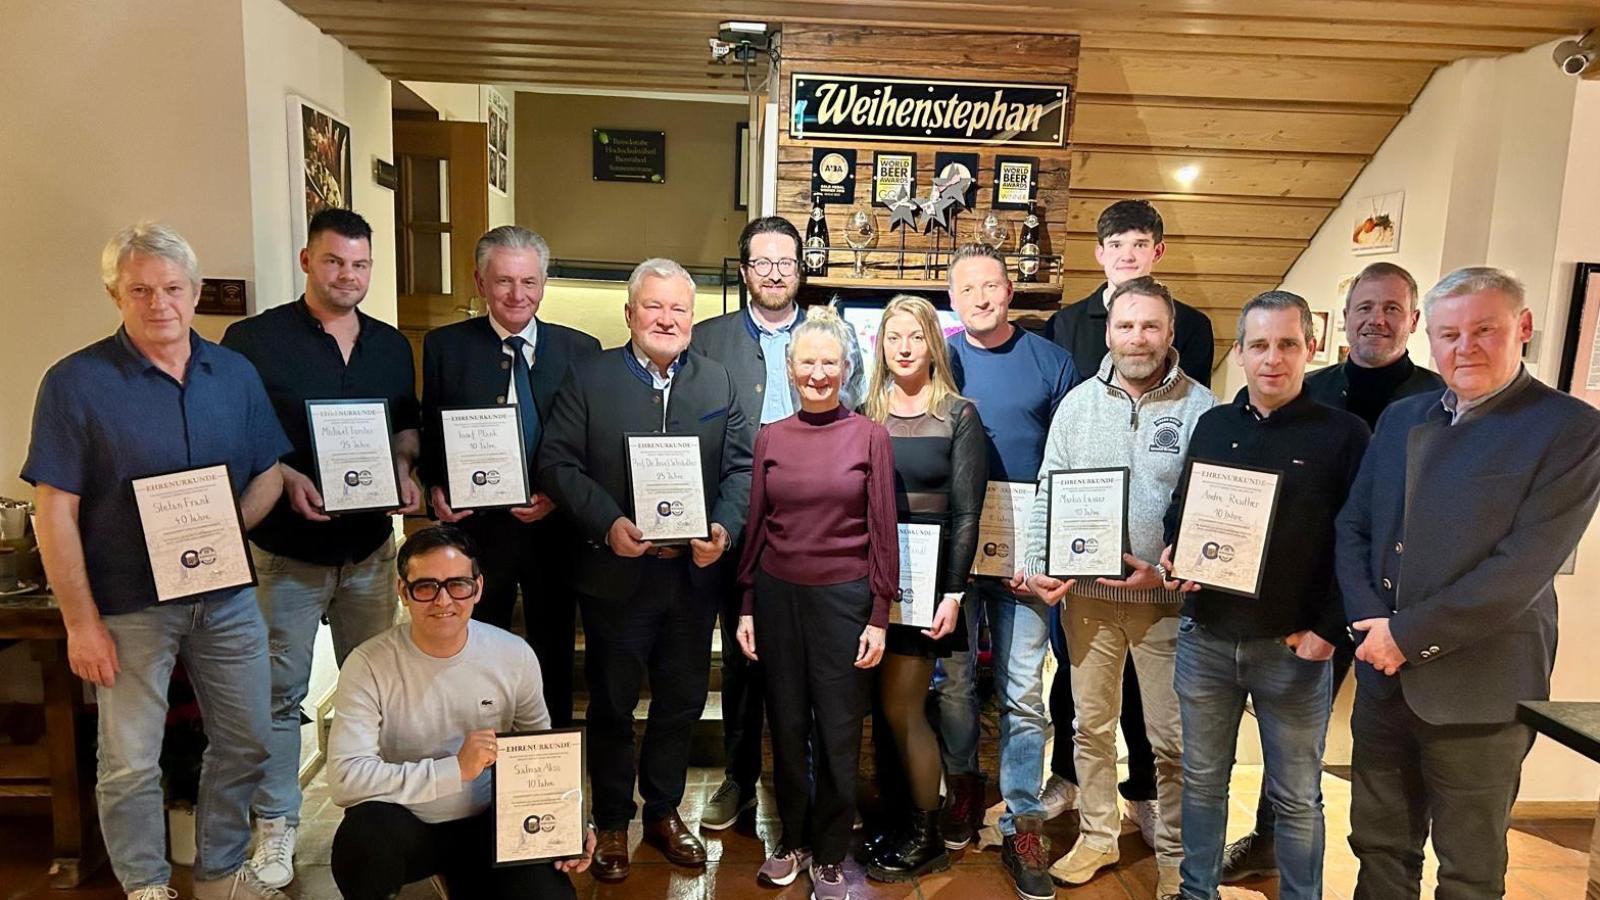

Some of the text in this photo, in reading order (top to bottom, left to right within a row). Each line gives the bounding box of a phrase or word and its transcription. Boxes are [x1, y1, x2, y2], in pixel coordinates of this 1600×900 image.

[815, 83, 1044, 136] Weihenstephan
[880, 160, 910, 168] WORLD
[880, 167, 908, 177] BEER
[1003, 174, 1027, 183] BEER
[320, 409, 376, 417] EHRENURKUNDE
[146, 474, 217, 492] EHRENURKUNDE
[1201, 470, 1266, 486] EHRENURKUNDE
[506, 742, 570, 752] EHRENURKUNDE
[528, 779, 556, 788] 10 Jahre
